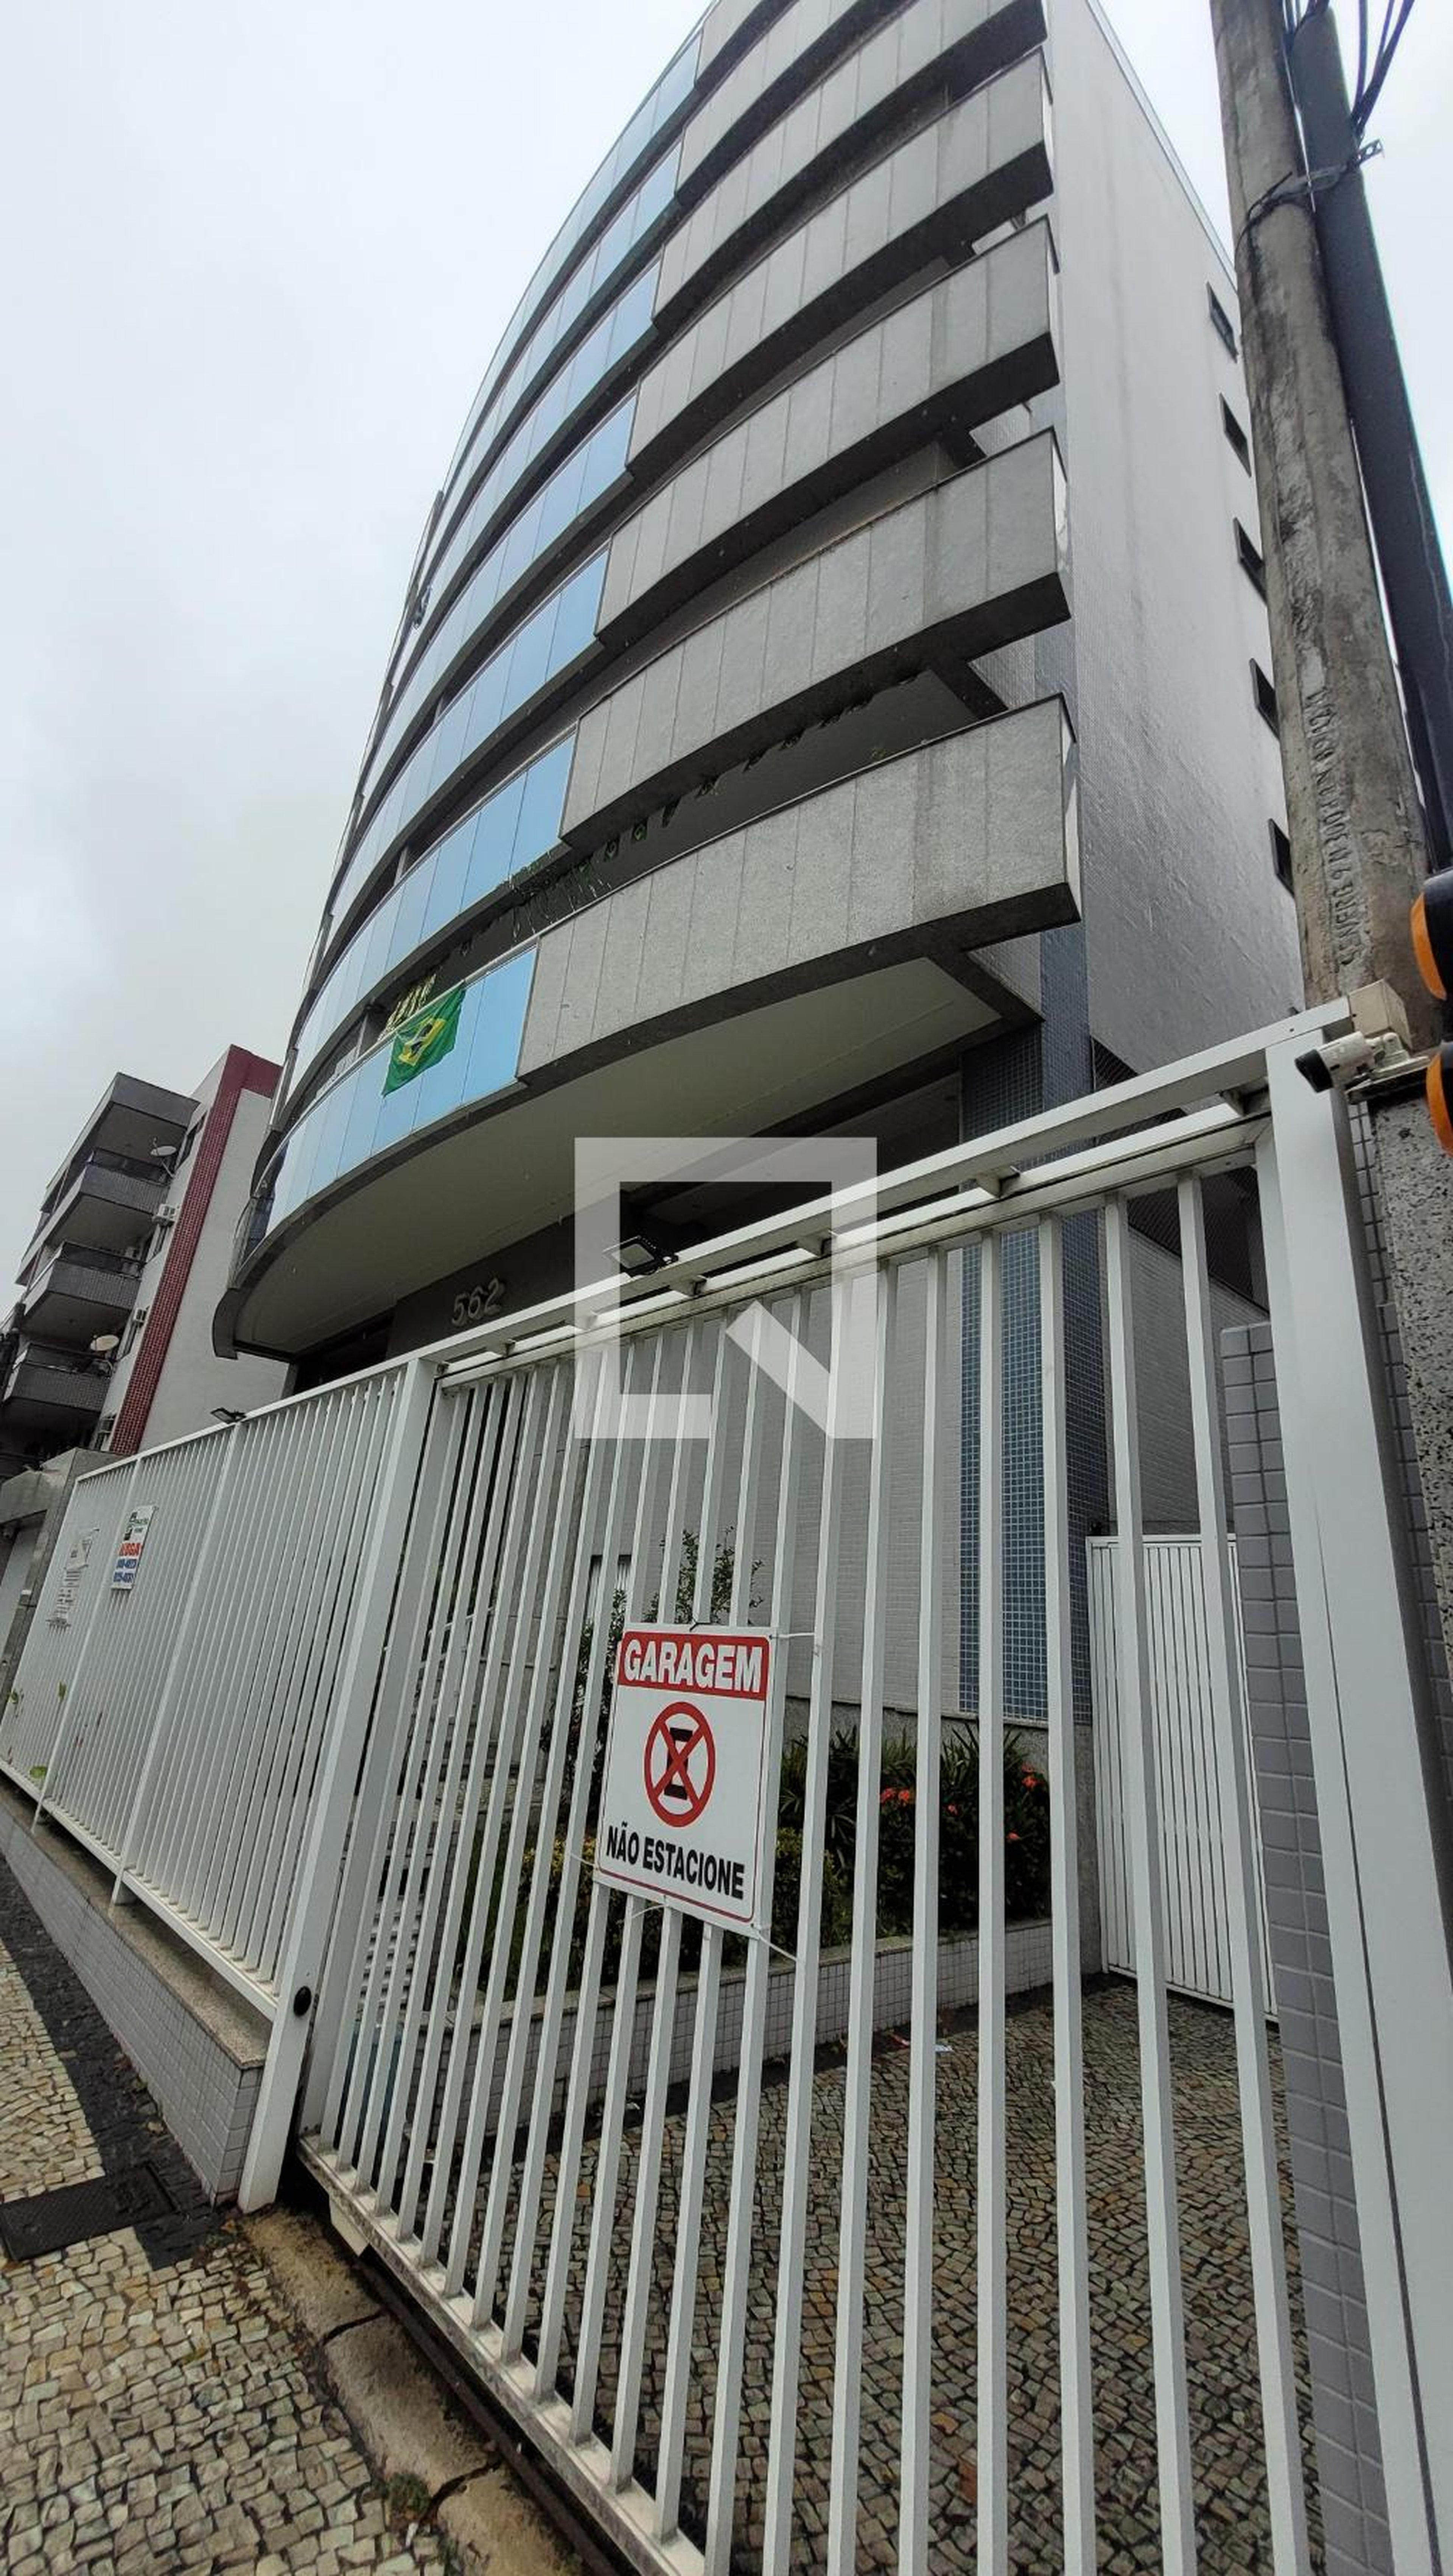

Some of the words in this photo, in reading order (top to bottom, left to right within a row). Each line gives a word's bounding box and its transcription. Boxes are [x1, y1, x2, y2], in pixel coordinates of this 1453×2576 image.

[452, 1277, 503, 1325] 562
[624, 1639, 763, 1693] GARAGEM
[607, 1821, 639, 1866] NÃO
[642, 1838, 745, 1900] ESTACIONE
